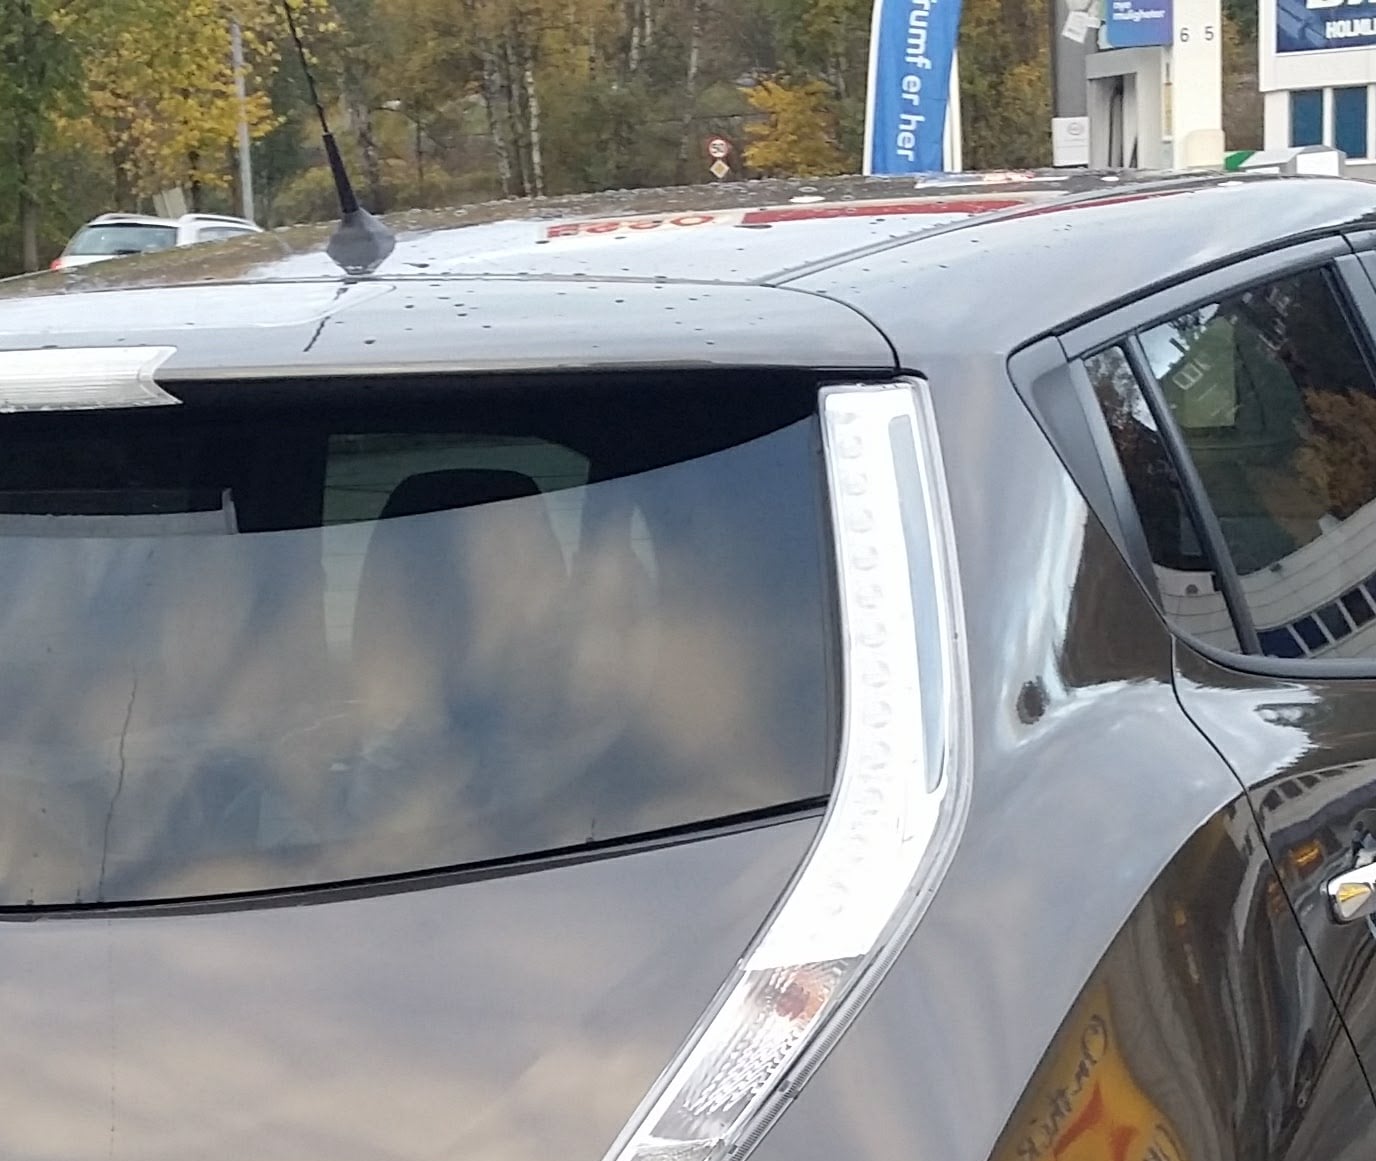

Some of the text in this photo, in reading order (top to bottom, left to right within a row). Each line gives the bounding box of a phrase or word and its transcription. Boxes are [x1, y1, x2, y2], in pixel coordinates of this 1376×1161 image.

[1179, 26, 1215, 43] 6 5
[896, 0, 935, 162] rumf er her
